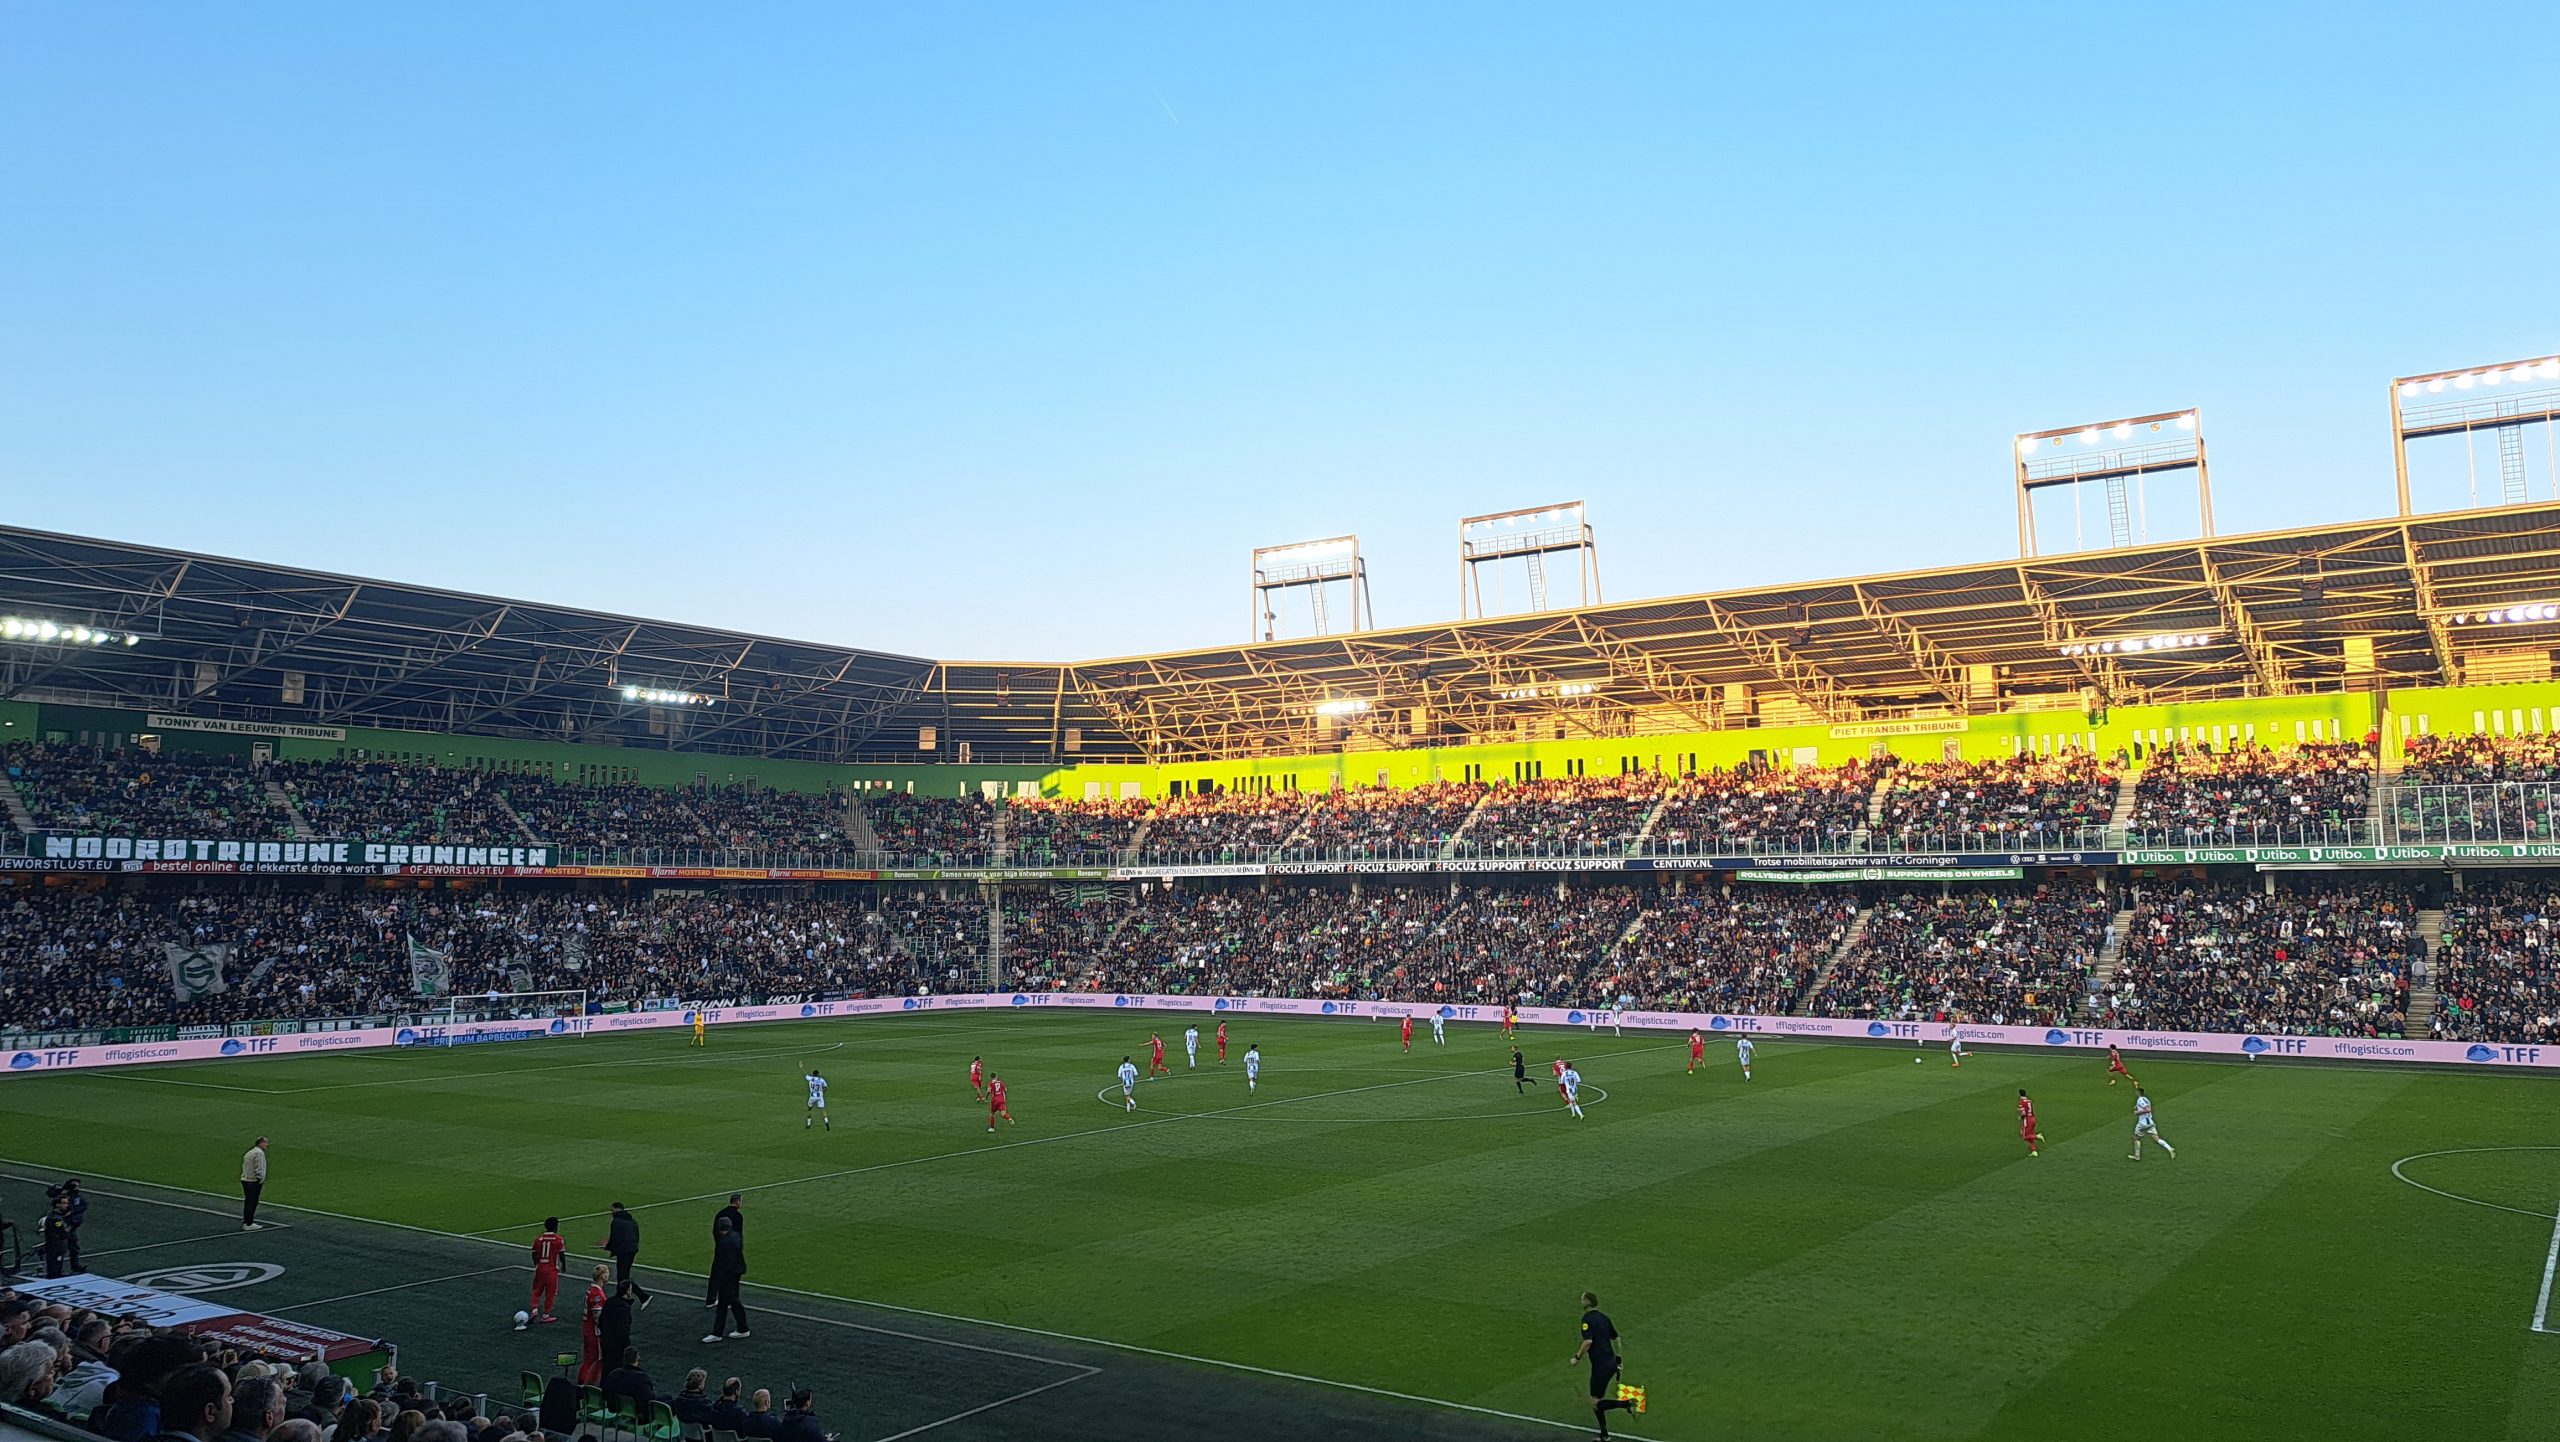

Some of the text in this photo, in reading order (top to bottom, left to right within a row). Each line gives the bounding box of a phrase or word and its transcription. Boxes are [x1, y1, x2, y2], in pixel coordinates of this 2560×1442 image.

[157, 717, 338, 738] TONNY VAN LEEUWEN TRIBUNE
[1835, 721, 1962, 736] PIET FRANSEN TRIBUNE
[365, 844, 547, 866] GRONINGEN
[2141, 852, 2177, 862] Utibo.
[2200, 852, 2238, 861] Utibo.
[2261, 850, 2301, 861] Utibo.
[2326, 849, 2366, 860] Utibo.
[2392, 847, 2434, 858] Utibo.
[2461, 846, 2504, 857] Utibo.
[1442, 861, 1526, 872] FOCUZ SUPPORT
[1536, 860, 1626, 871] FOCUZ SUPPORT
[1653, 859, 1713, 868] CENTURY.NL
[1753, 858, 1781, 866] Trotse
[1784, 857, 1868, 867] mobiliteitspartner
[1905, 856, 1958, 866] Groningen
[153, 861, 191, 871] bestel
[195, 862, 233, 872] online
[239, 863, 253, 873] de
[256, 862, 308, 873] lekkerste
[311, 864, 342, 875] droge
[345, 864, 376, 874] worst
[410, 866, 504, 876] OFJEWORSTLUST.EU
[544, 868, 581, 876] MOSTERD
[652, 867, 678, 877] Marne
[1273, 864, 1346, 874] FOCUZ SUPPORT
[1354, 863, 1430, 873] FOCUZ SUPPORT
[769, 869, 792, 879] Marne
[1741, 871, 1790, 880] ROLLYSIDE
[1790, 872, 1801, 880] FC
[1801, 871, 1859, 880] GRONINGEN
[1887, 870, 1954, 878] SUPPORTERS
[1968, 869, 2015, 877] WHEELS
[679, 998, 737, 1011] GRUNN
[1030, 994, 1050, 1004] TFF
[1129, 996, 1145, 1006] TFF
[1230, 999, 1298, 1010] TFF tfflogistics.com
[817, 1003, 883, 1014] TFF tfflogistics.com
[1339, 1003, 1413, 1015] TFF tfflogistics.com
[1458, 1007, 1478, 1018] TFF
[702, 1010, 776, 1021] TFF tfflogistics.com
[1588, 1012, 1678, 1025] TFF tfflogistics.com
[609, 1017, 658, 1027] tfflogistics.com
[1733, 1017, 1833, 1032] TFF tfflogistics.com
[231, 1021, 299, 1036] TEN BOER
[421, 1027, 446, 1038] TFF
[1892, 1023, 2005, 1039] TFF tffogistics.com
[248, 1035, 361, 1052] TFF tfflogistics.com
[434, 1031, 527, 1046] PREMIUM BARBECUES
[2073, 1031, 2198, 1047] TFF tfflogistics.com
[2273, 1038, 2415, 1056] TFF tfflogistics.com
[44, 1046, 178, 1066] TFF tfflogistics.com
[2501, 1046, 2540, 1063] TFF
[541, 1240, 551, 1259] 11
